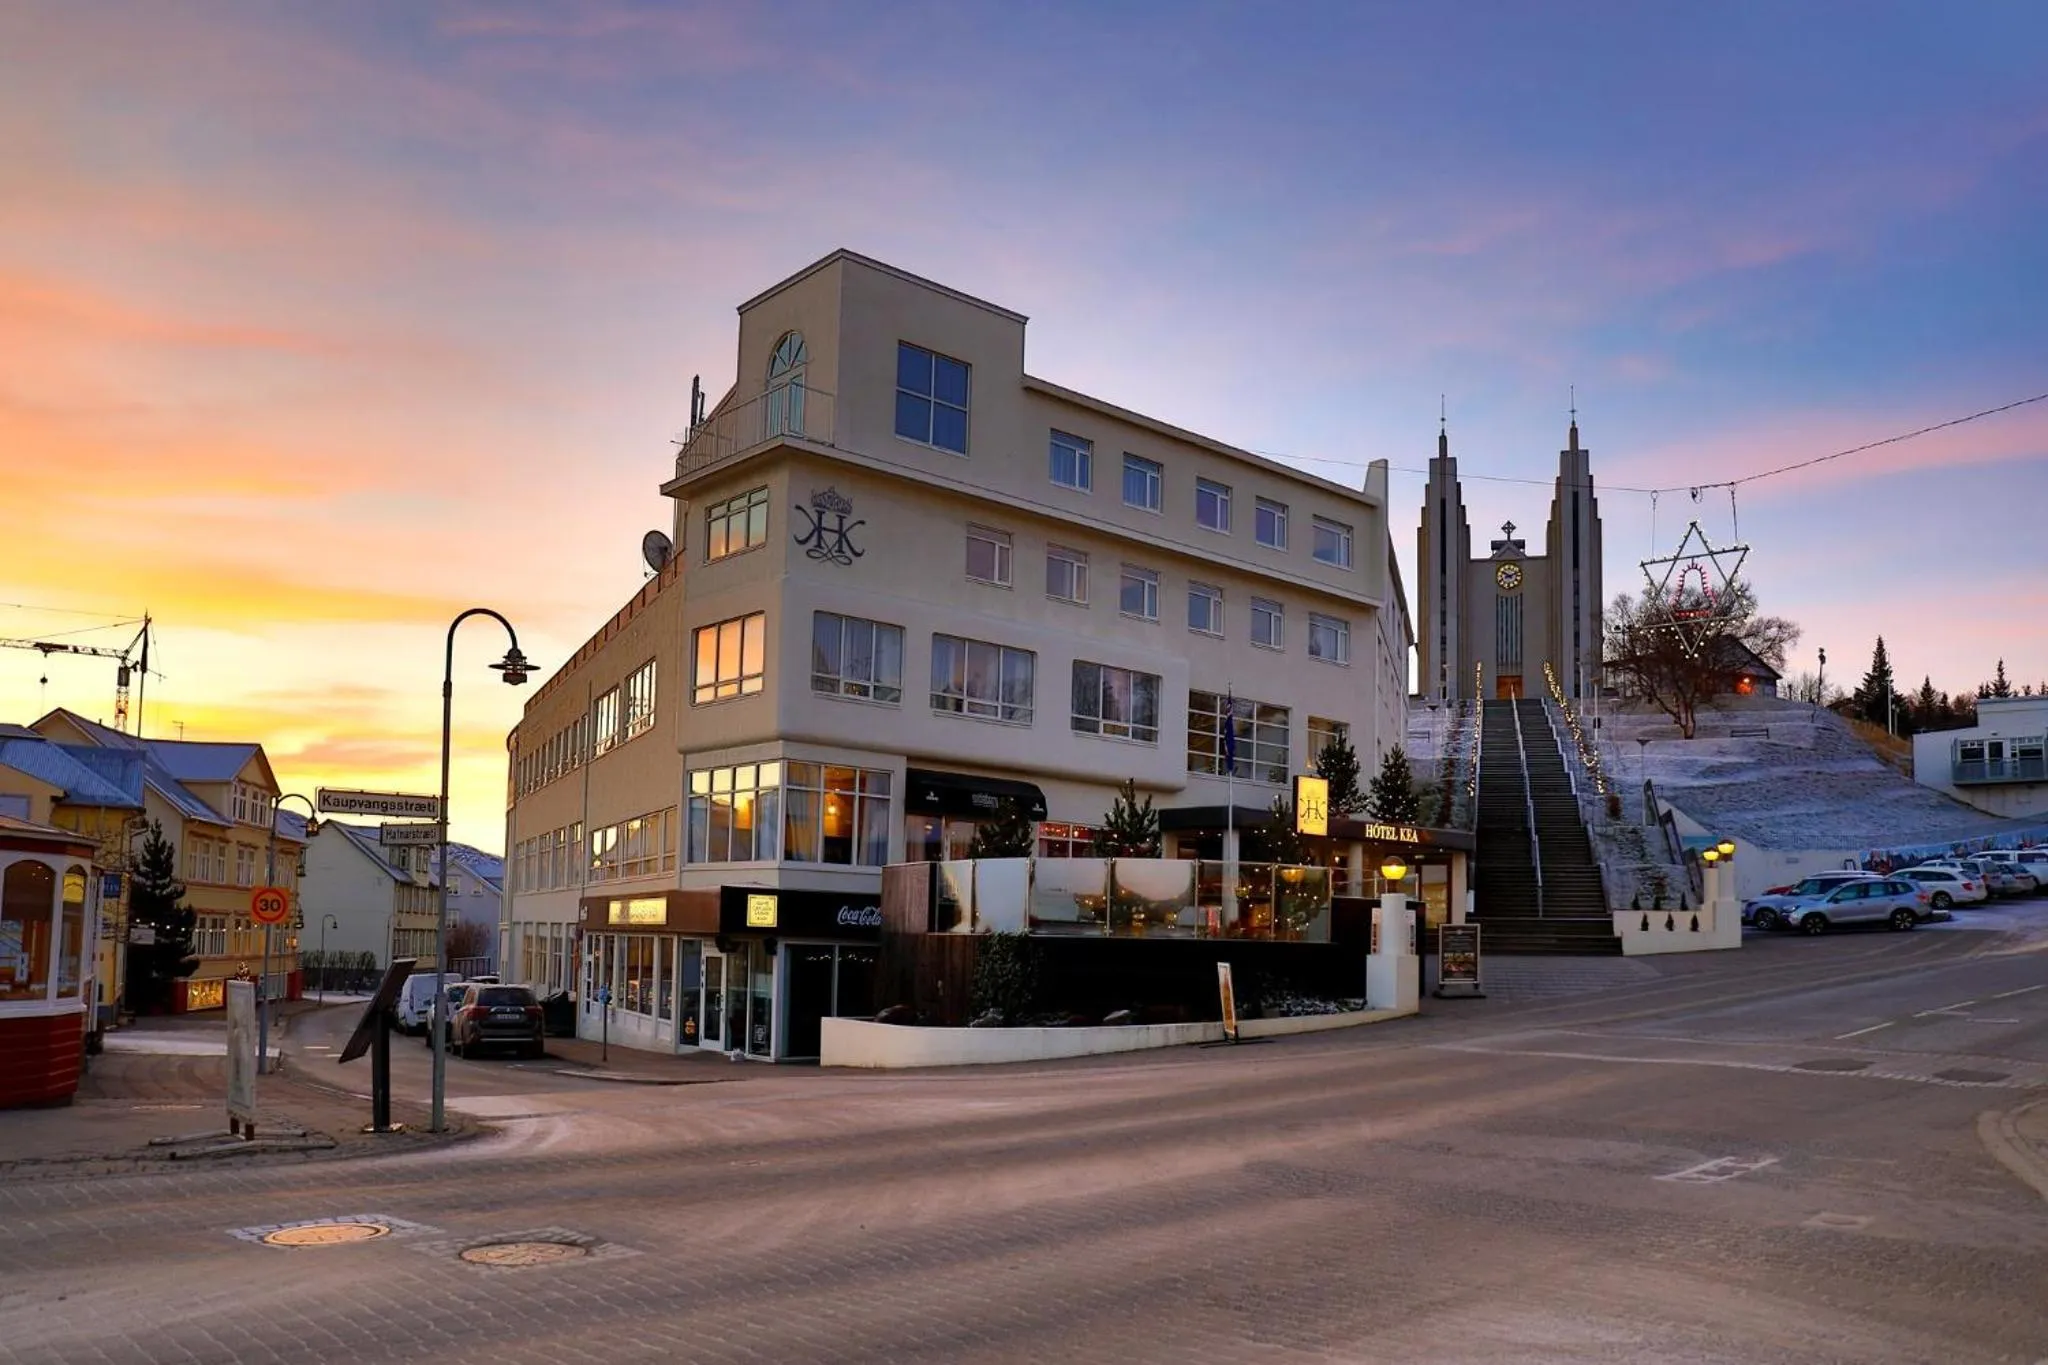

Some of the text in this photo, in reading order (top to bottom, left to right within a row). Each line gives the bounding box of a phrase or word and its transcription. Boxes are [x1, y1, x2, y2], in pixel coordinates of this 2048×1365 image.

[322, 794, 436, 814] Kaupvangsstræti
[1365, 822, 1419, 843] HÓTEL KEA
[259, 898, 281, 912] 30
